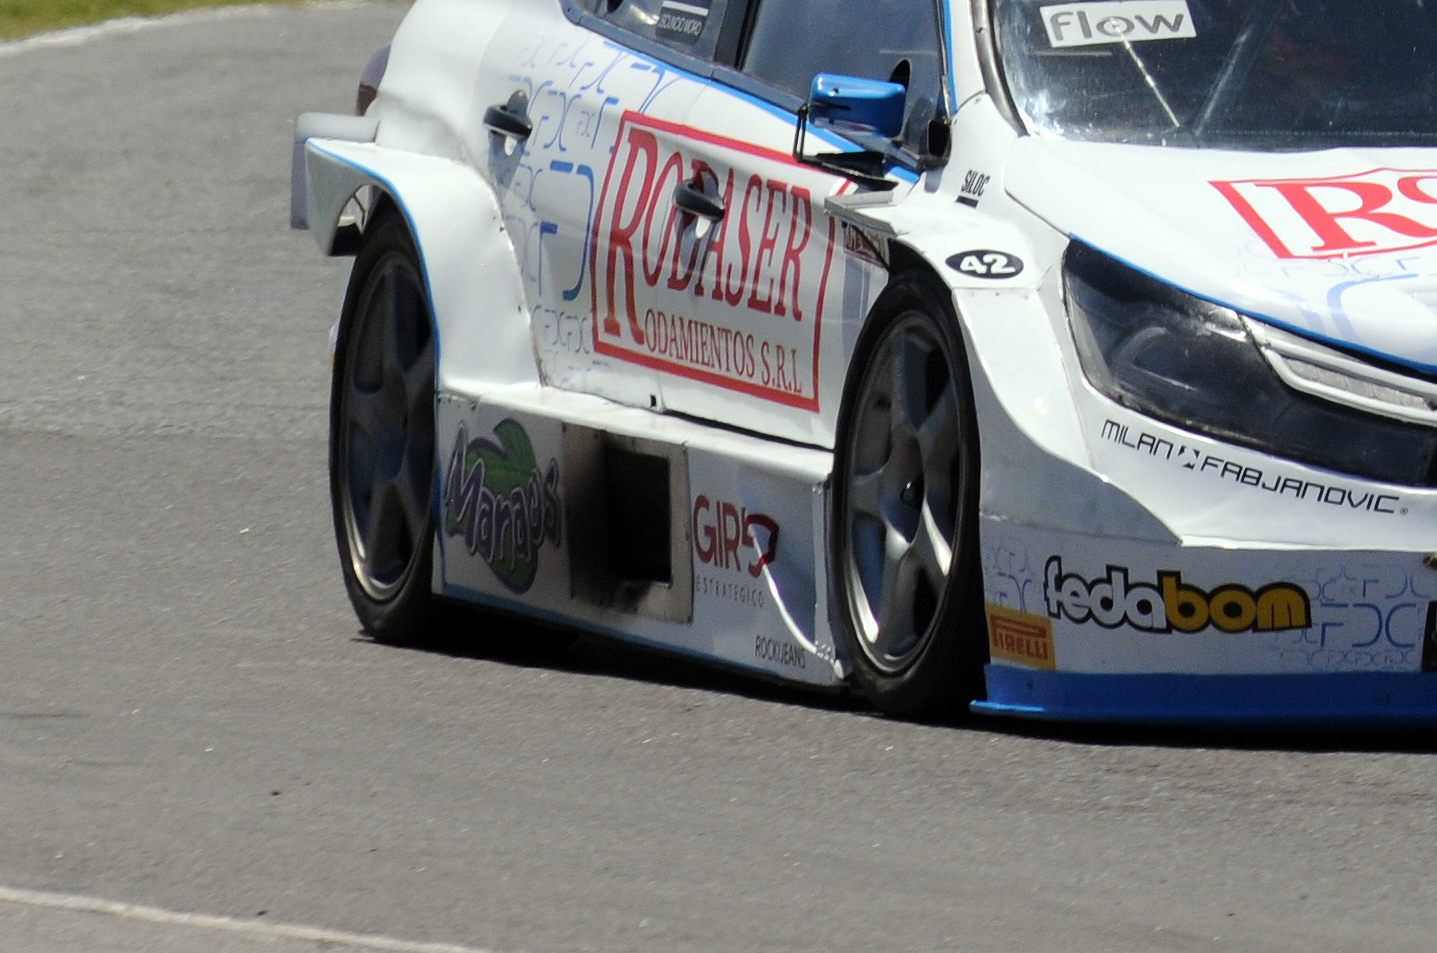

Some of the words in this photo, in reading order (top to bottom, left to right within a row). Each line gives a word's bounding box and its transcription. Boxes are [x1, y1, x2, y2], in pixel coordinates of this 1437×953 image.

[603, 128, 812, 345] RODASER
[959, 254, 1016, 275] 42
[446, 421, 562, 563] Manaos
[1101, 419, 1174, 460] MILAN
[1200, 455, 1400, 514] FABJANOVIC
[989, 614, 1049, 662] PIRELLI
[1044, 555, 1312, 634] fedabom
